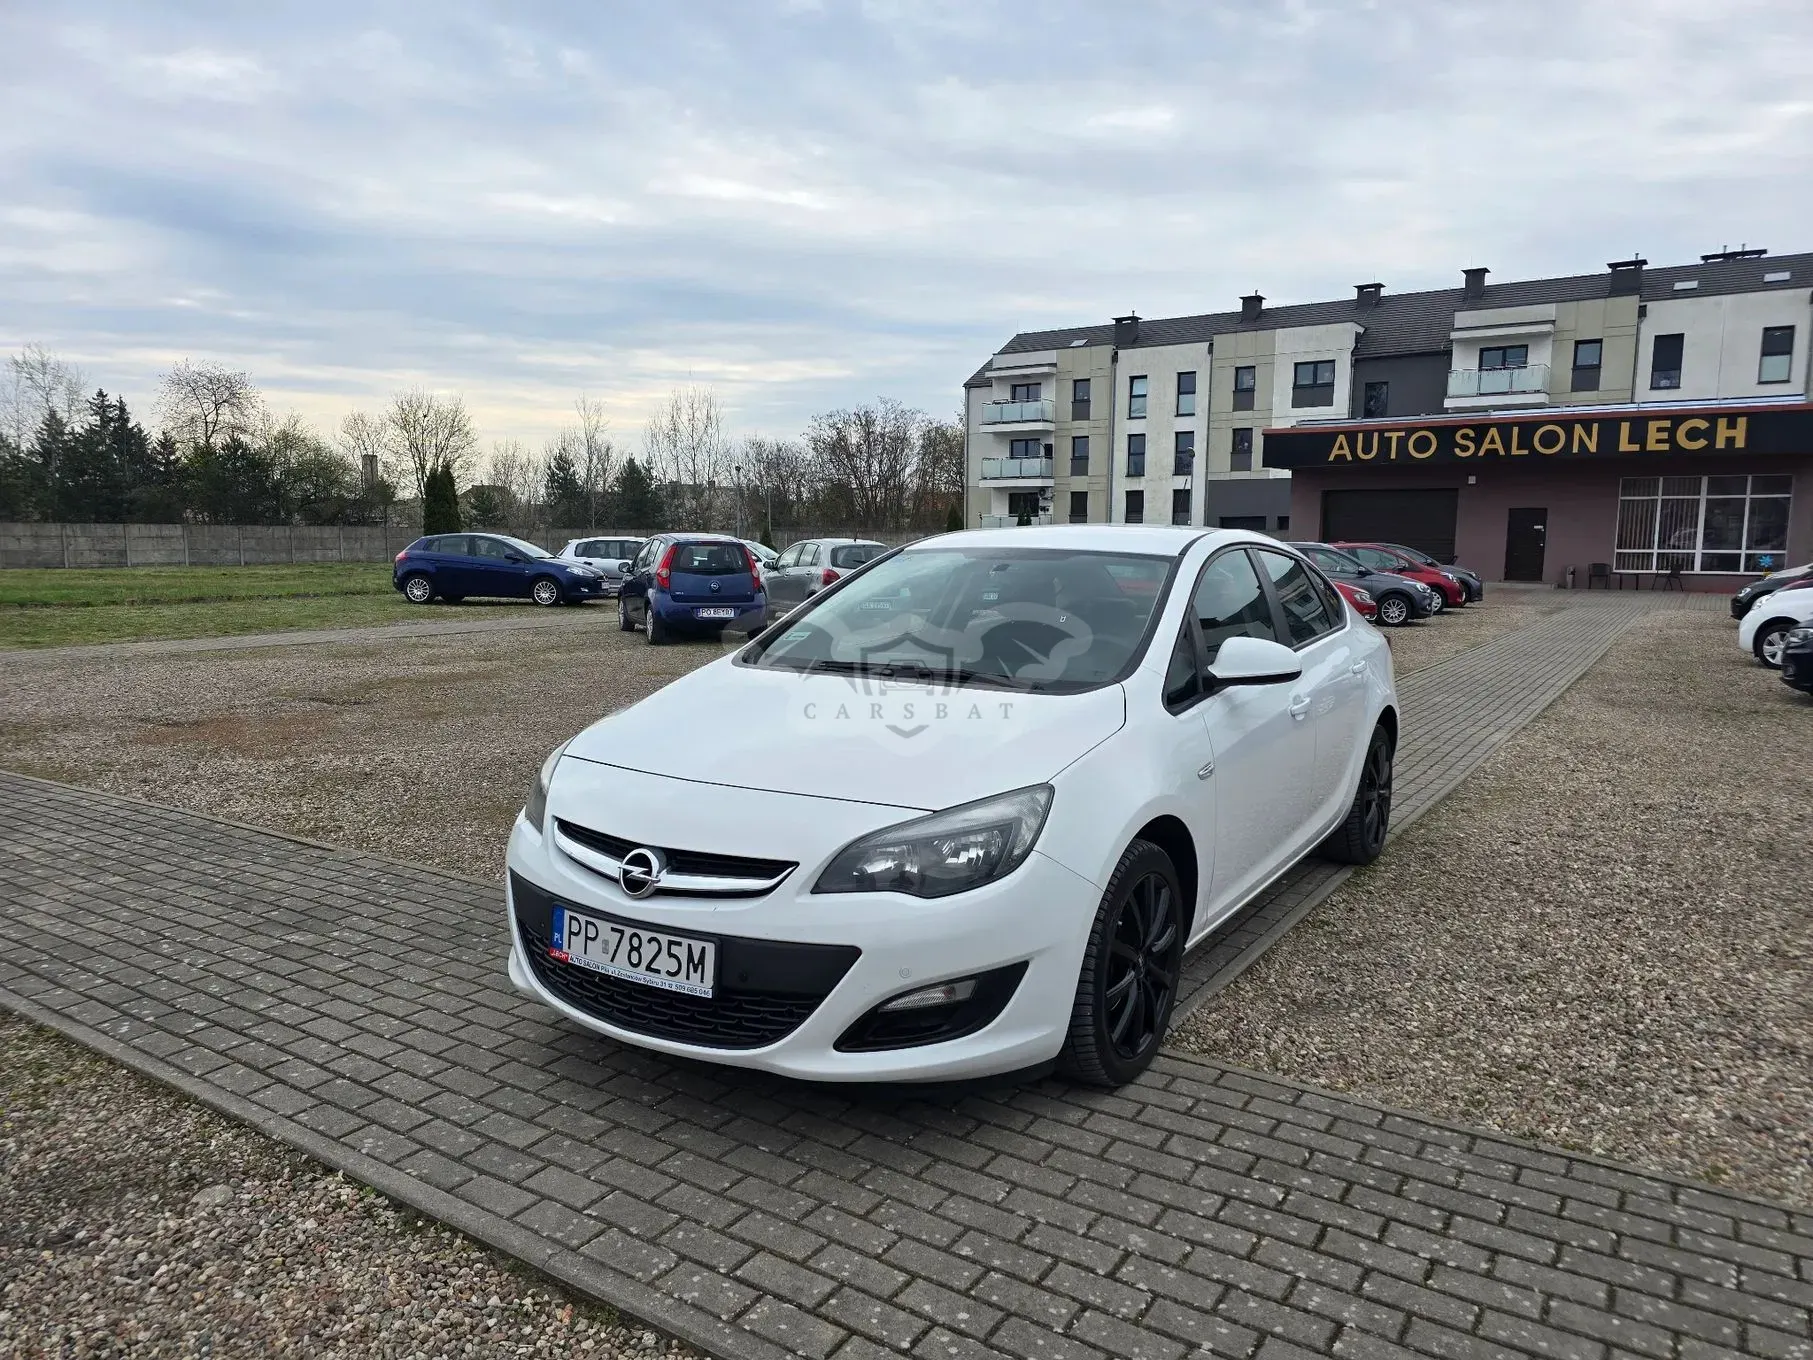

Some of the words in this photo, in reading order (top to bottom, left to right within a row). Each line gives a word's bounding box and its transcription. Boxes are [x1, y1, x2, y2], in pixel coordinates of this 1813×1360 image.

[1328, 430, 1438, 462] AUTO
[1454, 423, 1600, 459] SALON
[1618, 417, 1749, 452] LECH
[701, 608, 712, 616] PO
[554, 933, 562, 943] PL
[568, 915, 599, 955] PP
[610, 927, 707, 983] 7825M
[570, 955, 583, 965] AUTO
[583, 960, 600, 970] SALON
